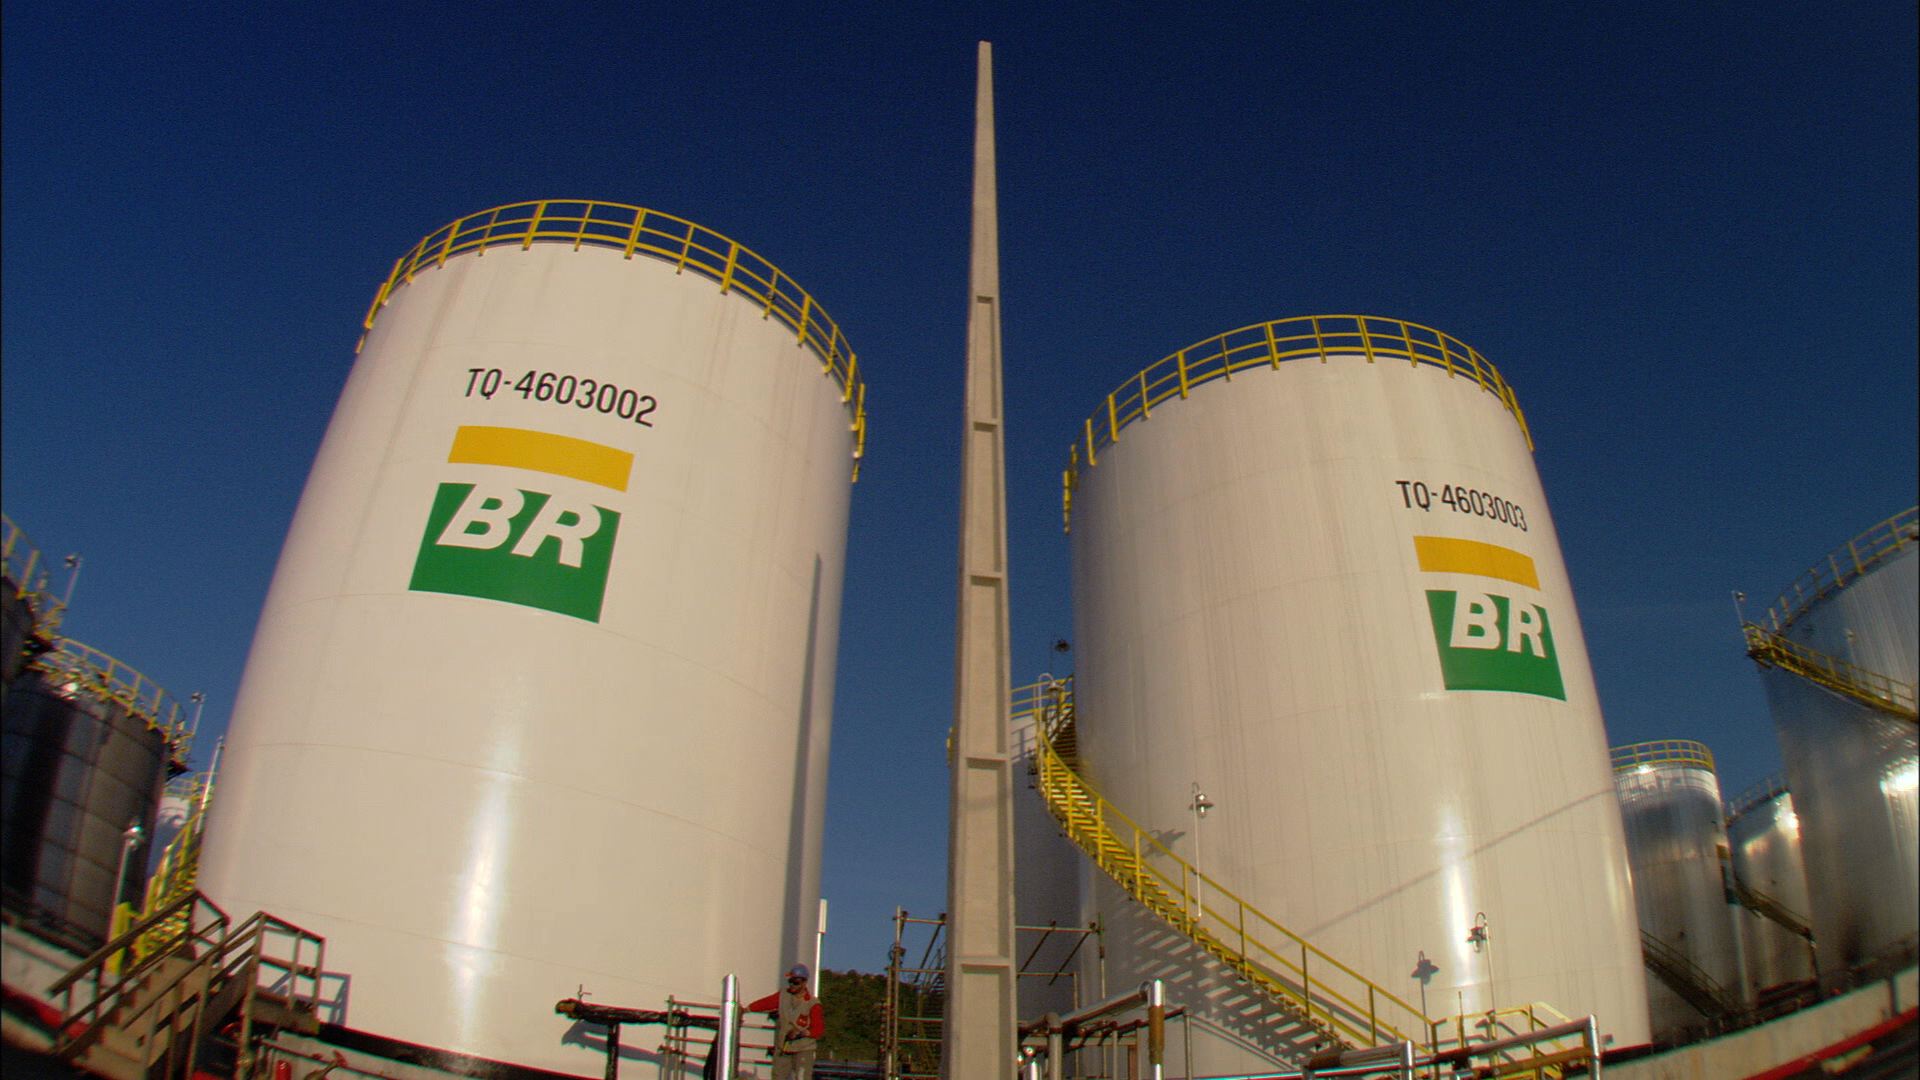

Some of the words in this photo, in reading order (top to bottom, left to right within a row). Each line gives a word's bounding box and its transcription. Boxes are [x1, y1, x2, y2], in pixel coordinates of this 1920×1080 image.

[465, 368, 657, 427] TQ-4603002
[435, 483, 602, 568] BR
[1395, 480, 1528, 532] TQ-4603003
[1450, 590, 1546, 658] BR
